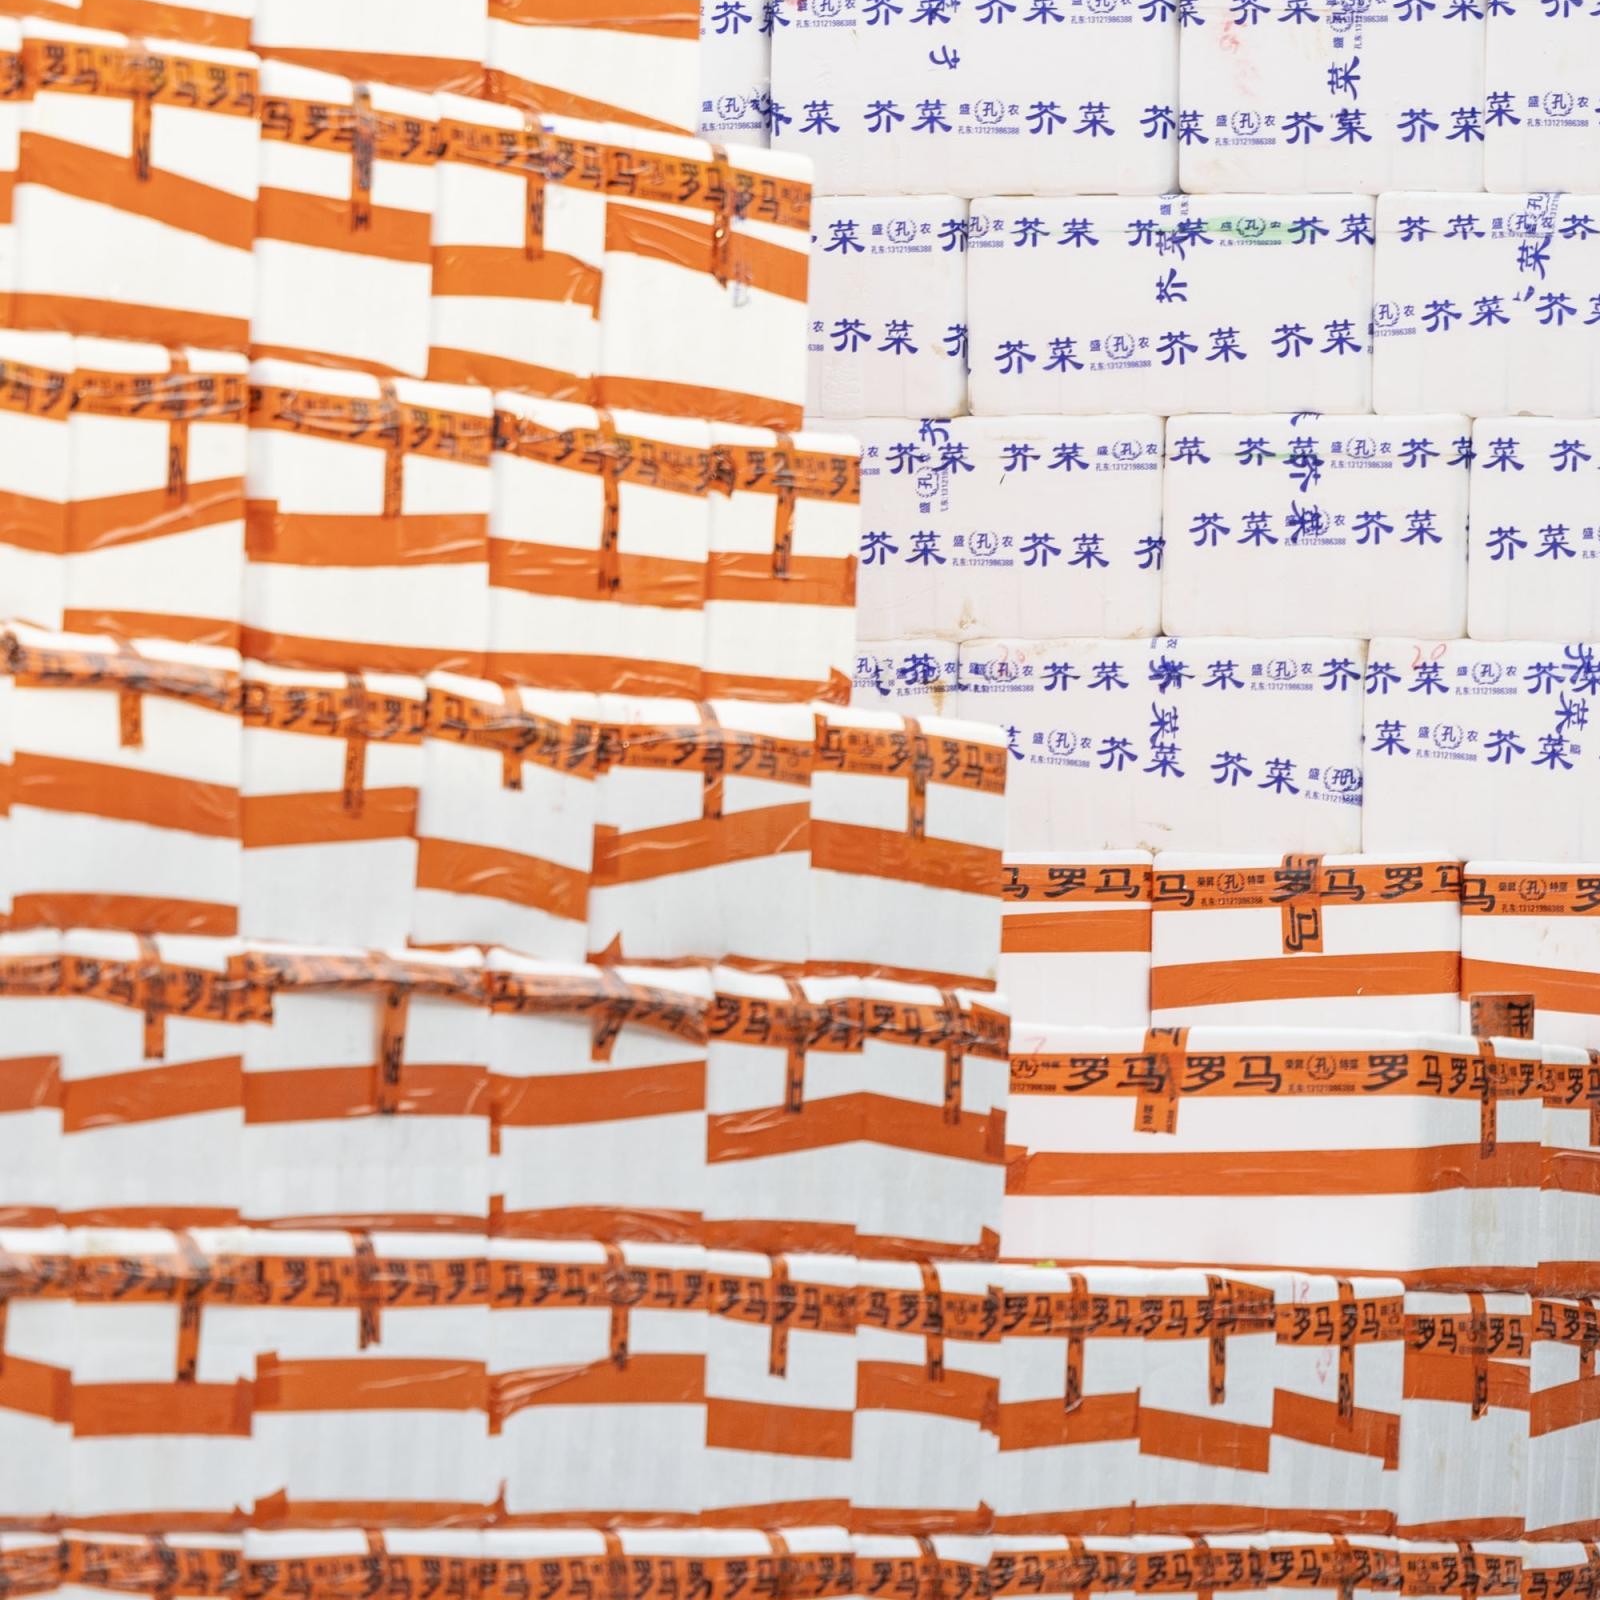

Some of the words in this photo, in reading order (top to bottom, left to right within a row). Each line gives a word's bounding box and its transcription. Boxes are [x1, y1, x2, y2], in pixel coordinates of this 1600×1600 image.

[863, 98, 953, 134] 芥菜
[1025, 100, 1115, 137] 芥菜
[1281, 107, 1373, 145] 芥菜
[1395, 105, 1485, 144] 芥菜
[1014, 217, 1100, 248] 芥菜
[1289, 212, 1376, 246] 芥菜
[1399, 214, 1486, 243] 芥菜
[1422, 295, 1511, 333] 芥菜
[831, 318, 919, 354] 芥菜
[994, 336, 1085, 375] 芥菜
[1156, 327, 1247, 367] 芥菜
[1272, 319, 1362, 359] 芥菜
[1004, 442, 1090, 472] 芥菜
[1189, 511, 1279, 547] 芥菜
[1351, 510, 1442, 545] 芥菜
[1487, 524, 1577, 561] 芥菜
[861, 531, 946, 565] 芥菜
[1019, 532, 1110, 568] 芥菜
[1043, 661, 1129, 692] 芥菜
[1366, 662, 1450, 695] 芥菜
[1484, 728, 1576, 770] 芥菜
[1211, 751, 1300, 795] 芥菜
[1045, 868, 1140, 899] 罗马
[1066, 1055, 1166, 1094] 罗马
[1182, 1055, 1282, 1093] 罗马
